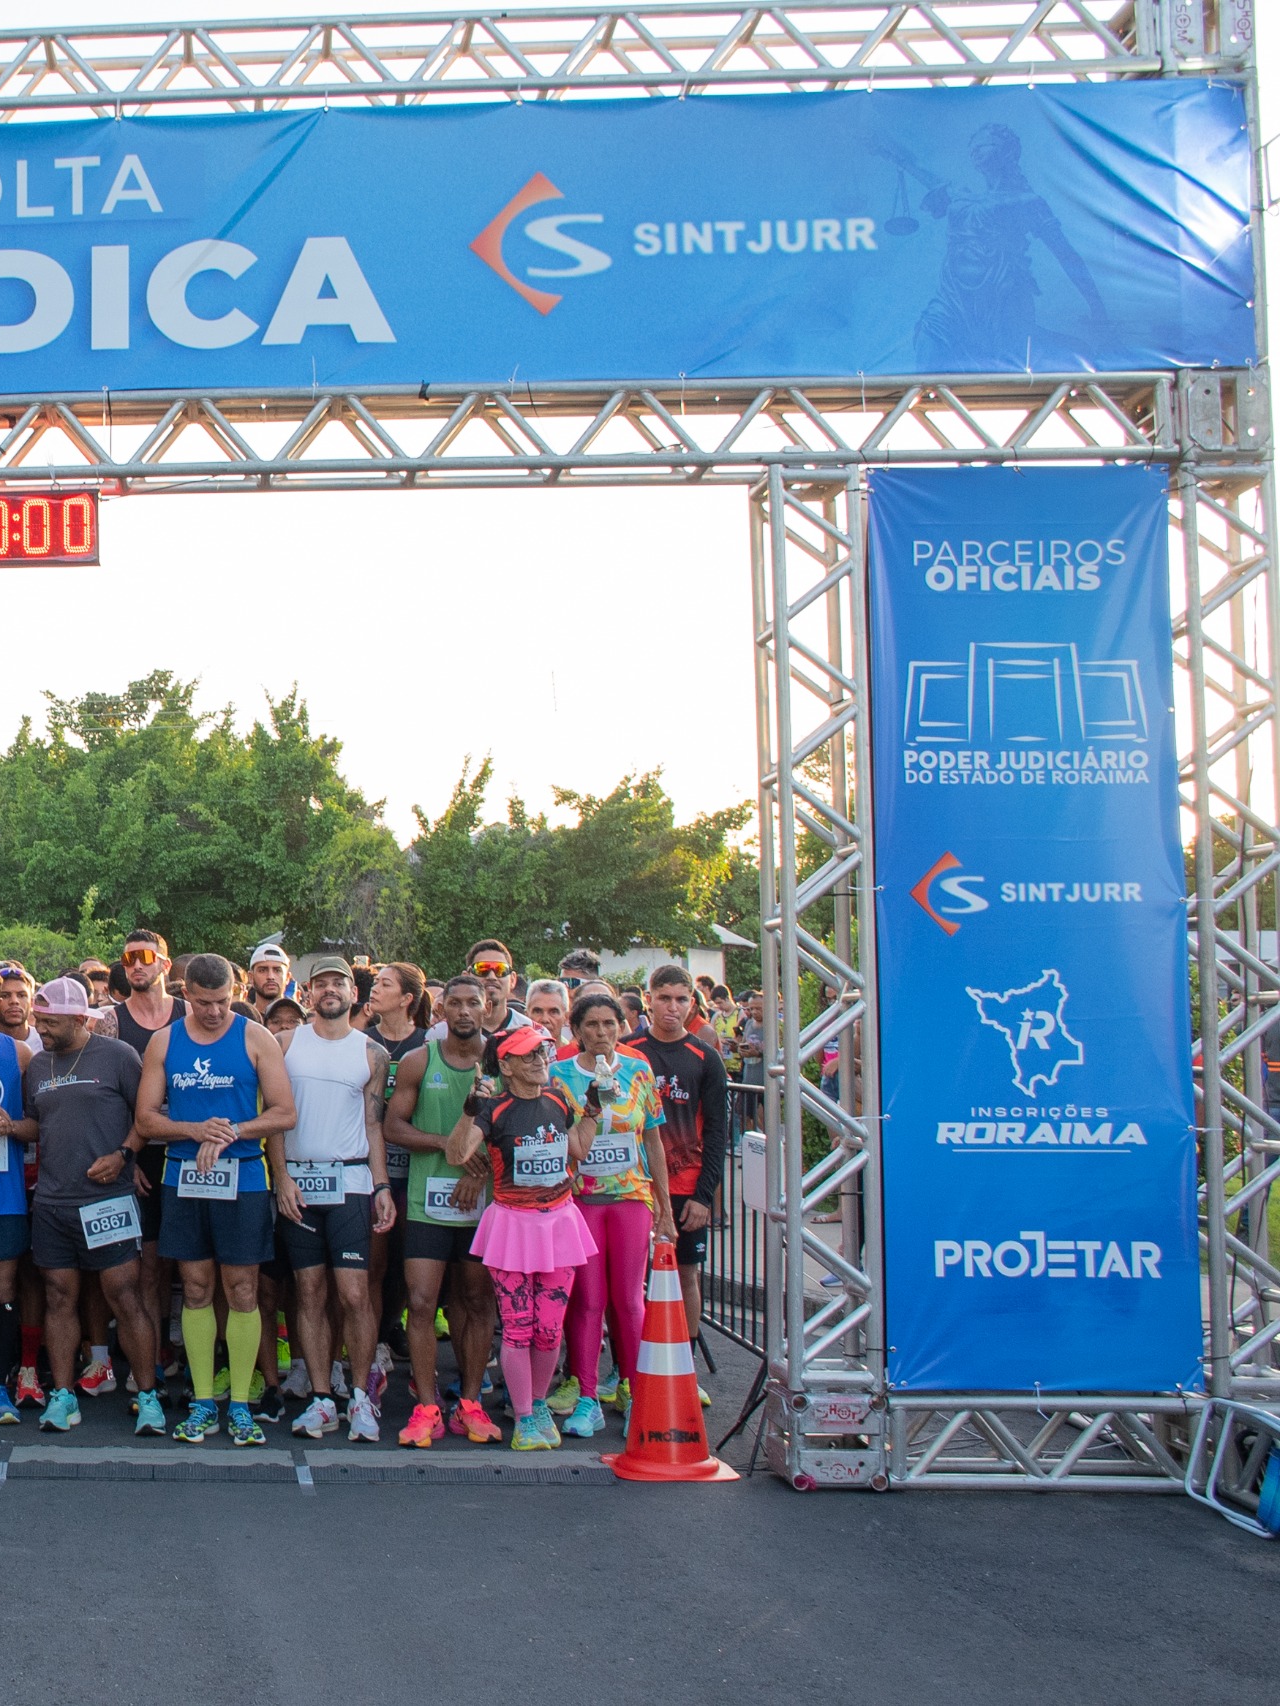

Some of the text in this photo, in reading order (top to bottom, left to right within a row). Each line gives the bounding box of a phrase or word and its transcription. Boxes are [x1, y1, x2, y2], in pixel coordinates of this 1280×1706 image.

[633, 217, 878, 256] SINTJURR
[912, 540, 1126, 566] PARCEIROS
[925, 565, 1100, 591] OFICIAIS
[904, 745, 1149, 770] PODER JUDICIÁRIO
[905, 769, 1149, 784] DO ESTADO DE RORAIMA
[1001, 882, 1142, 903] SINTJURR
[970, 1104, 1109, 1120] INSCRIÇÕES
[936, 1122, 1148, 1145] RORAIMA
[521, 1158, 561, 1174] 0506
[585, 1149, 626, 1164] 0805
[186, 1171, 226, 1185] 0330
[296, 1177, 330, 1191] 0091
[90, 1212, 126, 1234] 0867
[935, 1231, 1162, 1279] PROJETAR
